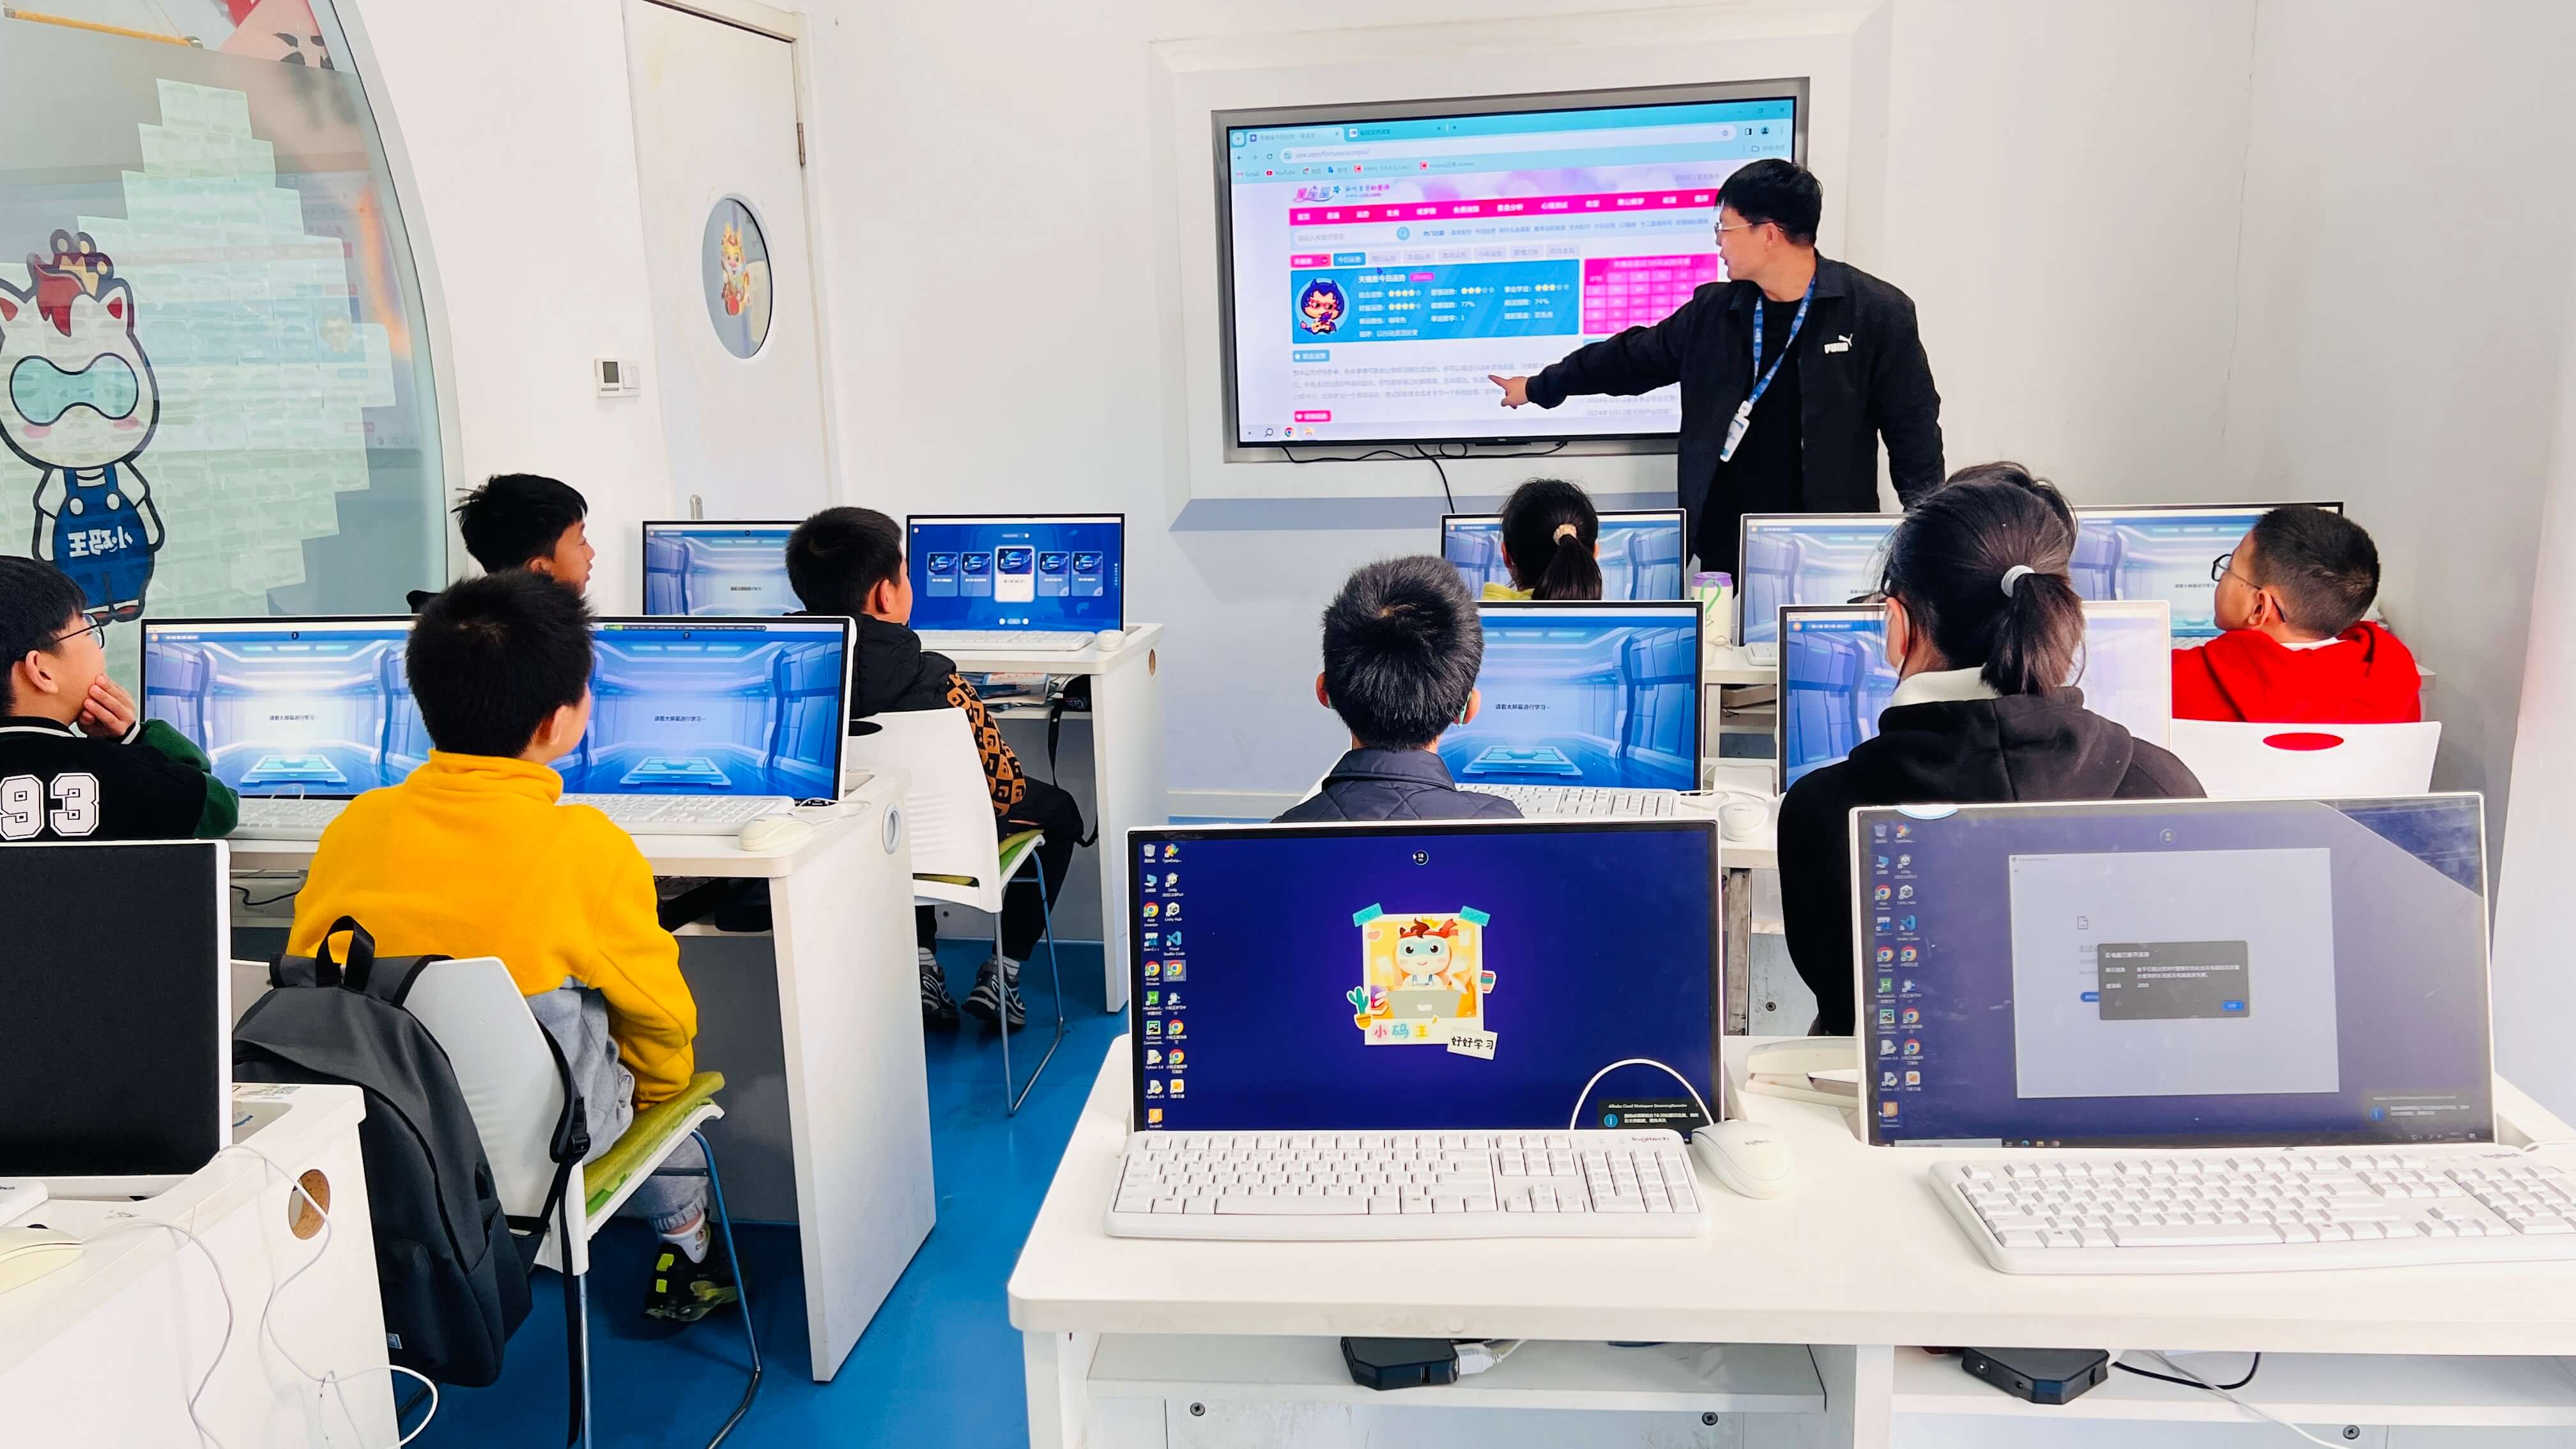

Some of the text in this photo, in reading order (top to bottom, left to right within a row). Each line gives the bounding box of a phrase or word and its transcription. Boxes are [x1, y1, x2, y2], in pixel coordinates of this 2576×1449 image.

[0, 772, 100, 840] 93
[1374, 1023, 1429, 1038] 小码王
[1451, 1035, 1494, 1050] 好好学习
